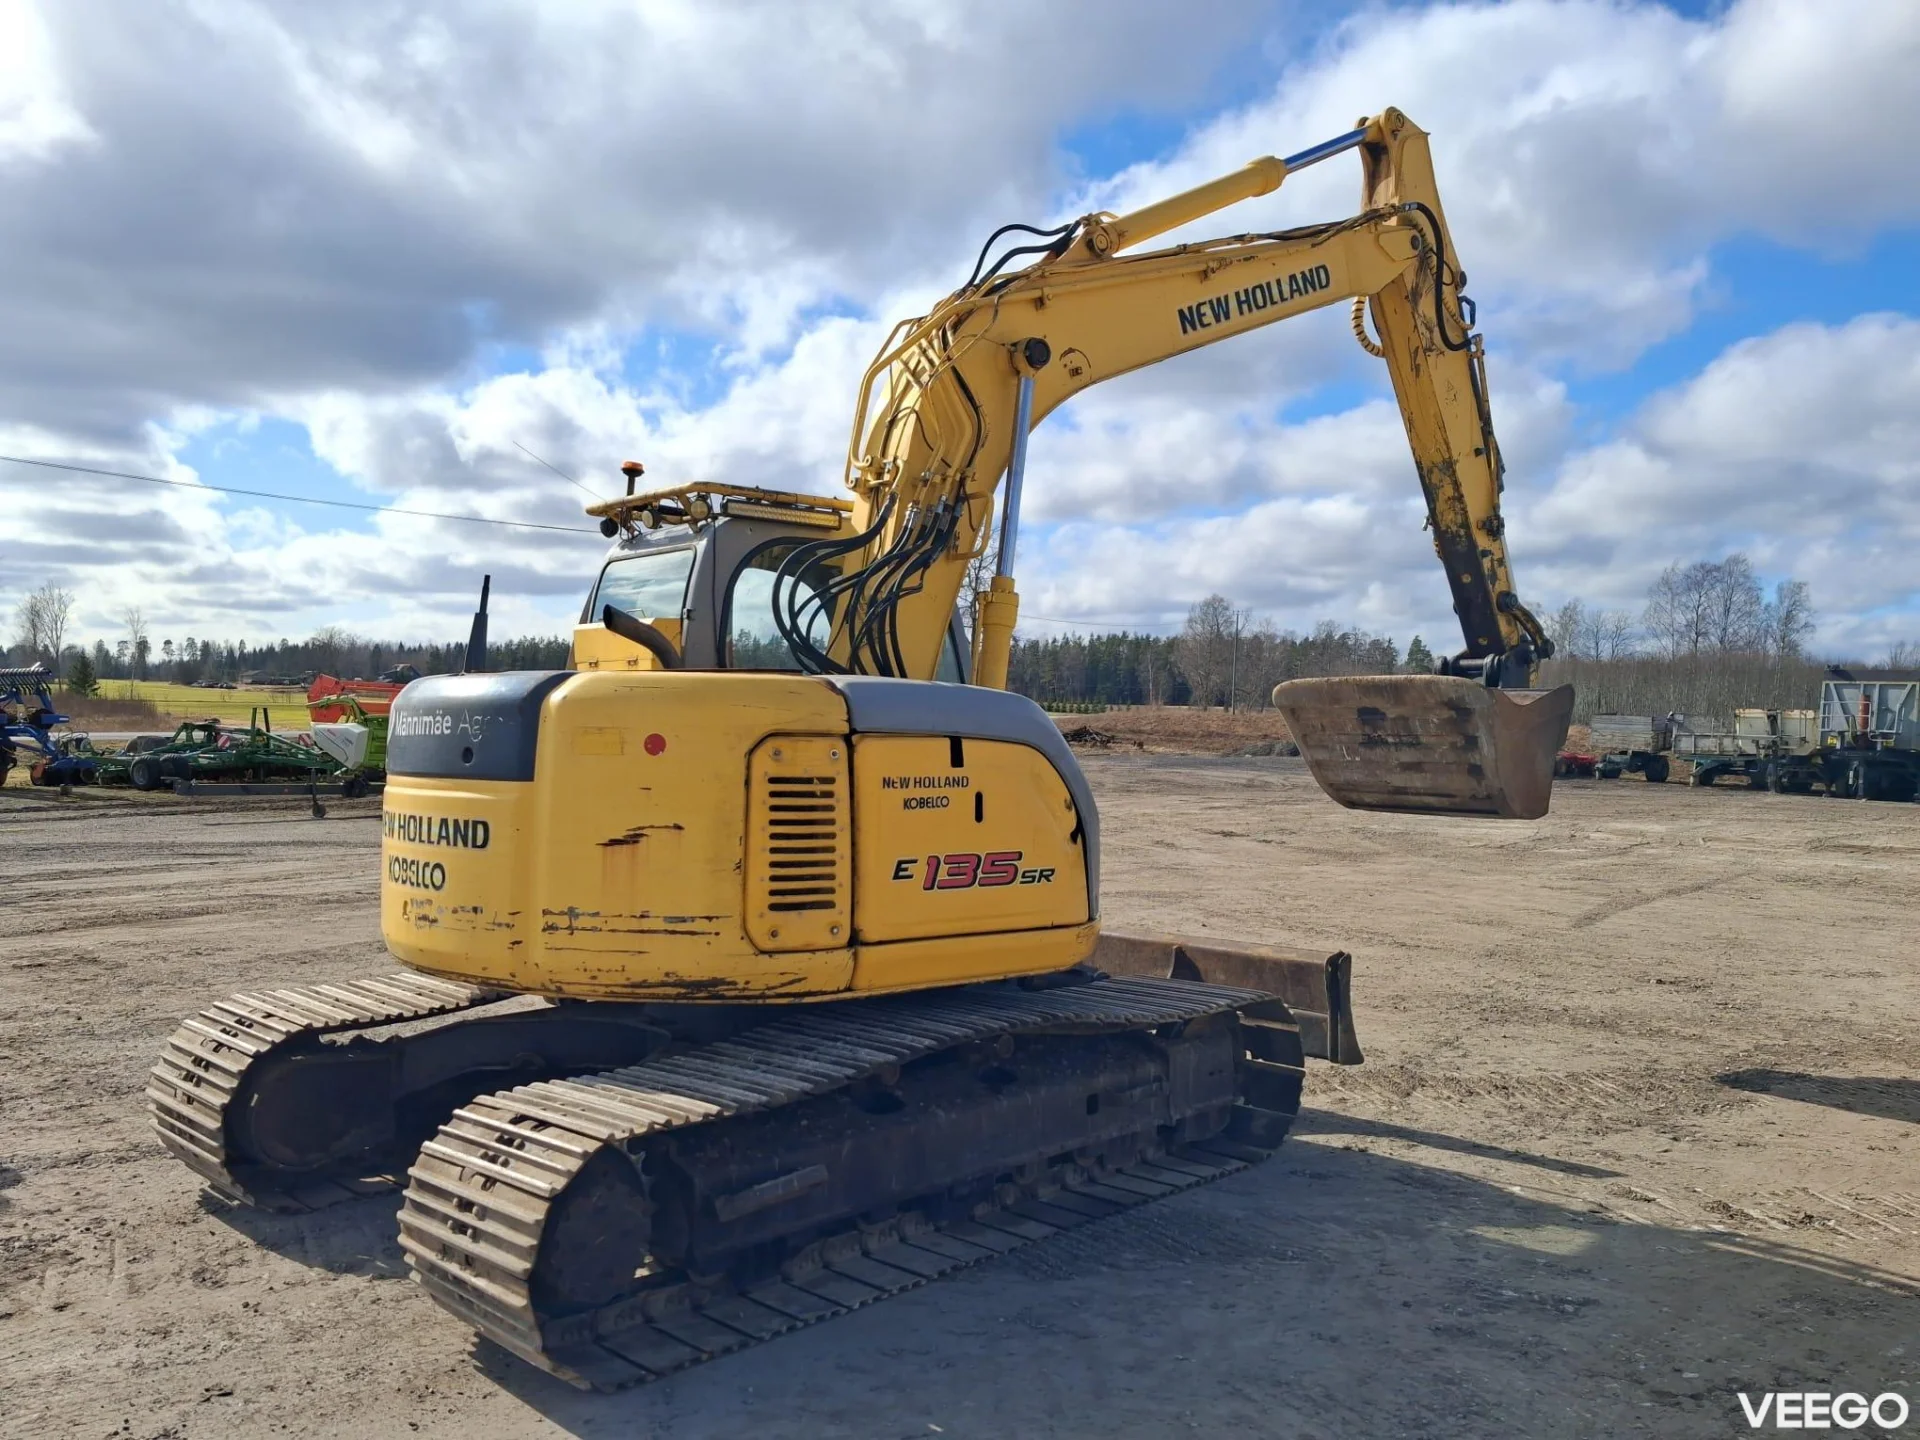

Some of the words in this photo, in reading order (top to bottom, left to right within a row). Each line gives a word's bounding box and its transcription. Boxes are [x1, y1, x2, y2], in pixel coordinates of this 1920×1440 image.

[1177, 294, 1231, 335] NEW
[1234, 264, 1331, 316] HOLLAND
[882, 776, 910, 789] NEW
[914, 776, 969, 788] HOLLAND
[903, 796, 949, 810] KOBELCO
[383, 810, 396, 839] EW
[397, 814, 490, 849] HOLLAND
[388, 855, 446, 891] KOBELCO
[892, 859, 918, 880] E
[922, 851, 1023, 890] 135
[1019, 868, 1056, 884] SR
